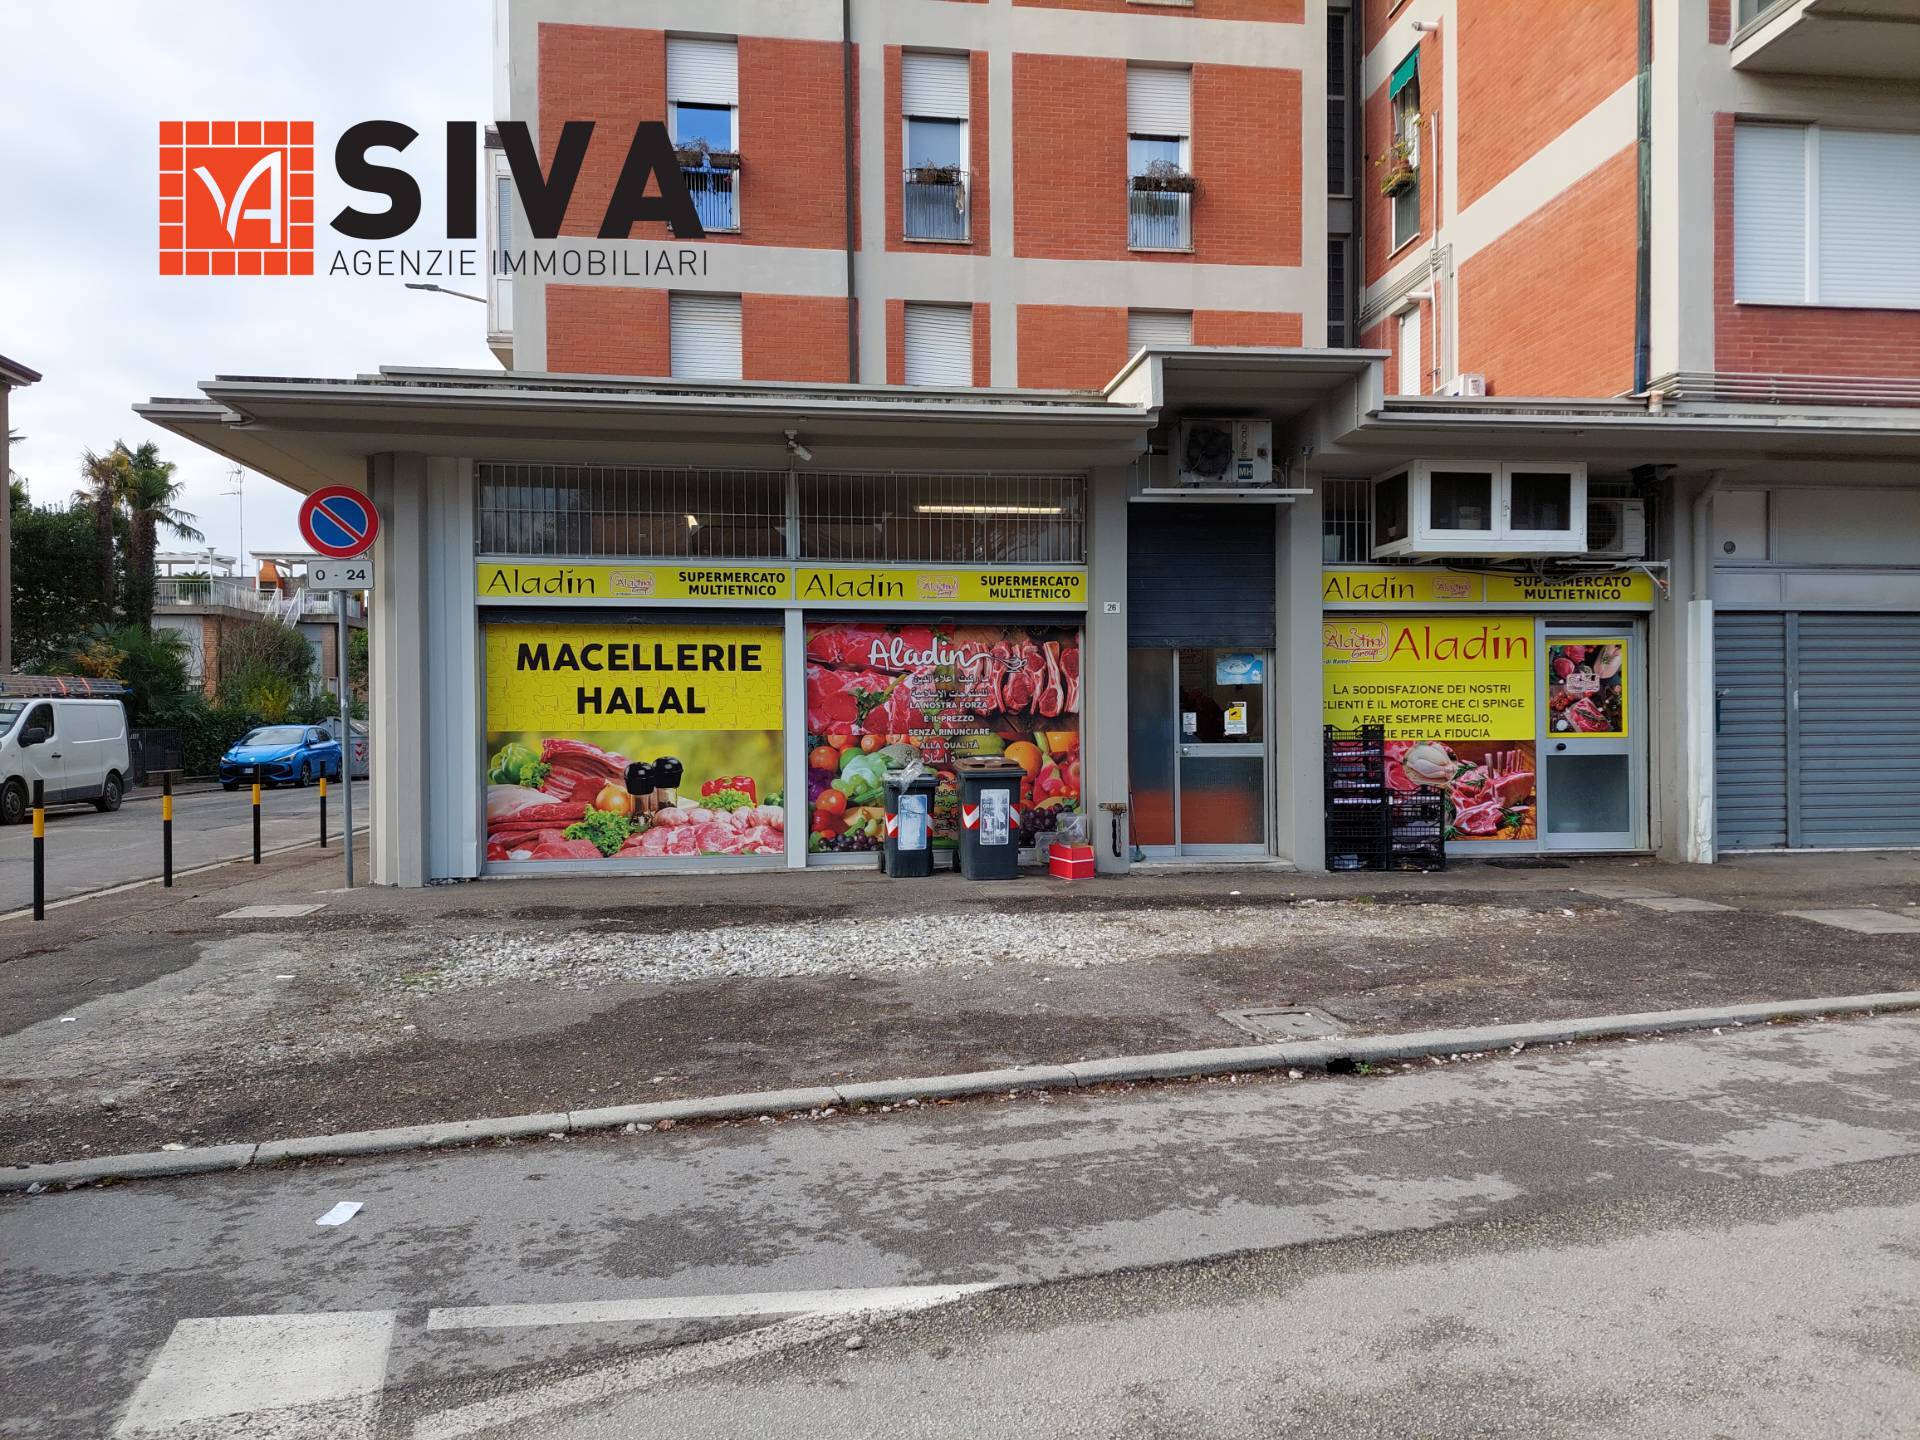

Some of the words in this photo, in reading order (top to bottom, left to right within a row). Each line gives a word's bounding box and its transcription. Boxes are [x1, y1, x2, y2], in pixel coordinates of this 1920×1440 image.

[346, 570, 366, 580] 24
[678, 571, 786, 583] SUPERMERCATO
[980, 575, 1080, 587] SUPERMERCATO
[486, 568, 596, 595] Aladin
[803, 573, 904, 598] Aladin
[688, 584, 777, 596] MULTIETNICO
[989, 588, 1071, 599] MULTIETNICO
[1324, 576, 1415, 600] Aladin
[1524, 588, 1622, 600] MULTIETNICO
[1107, 603, 1117, 612] 26
[1389, 623, 1529, 662] Aladin
[517, 643, 762, 672] MACELLERIE
[867, 637, 986, 670] Aladin
[1352, 685, 1444, 694] SODDISFAZIONE
[1447, 685, 1466, 693] DEI
[1469, 684, 1511, 693] NOSTRI
[577, 687, 706, 715] HALAL
[1377, 700, 1387, 709] IL
[1390, 700, 1439, 708] MOTORE
[1441, 700, 1465, 708] CHE
[1468, 700, 1480, 708] CI
[1482, 699, 1525, 708] SPINGE
[1352, 715, 1360, 724] A
[1363, 715, 1393, 723] FARE
[1396, 714, 1443, 723] SEMPRE
[1446, 714, 1493, 724] MEGLIO,
[938, 728, 990, 736] RINUNCIARE
[1401, 729, 1424, 738] PER
[1427, 729, 1441, 738] LA
[1444, 729, 1490, 738] FIDUCIA
[943, 740, 980, 750] QUALITÀ
